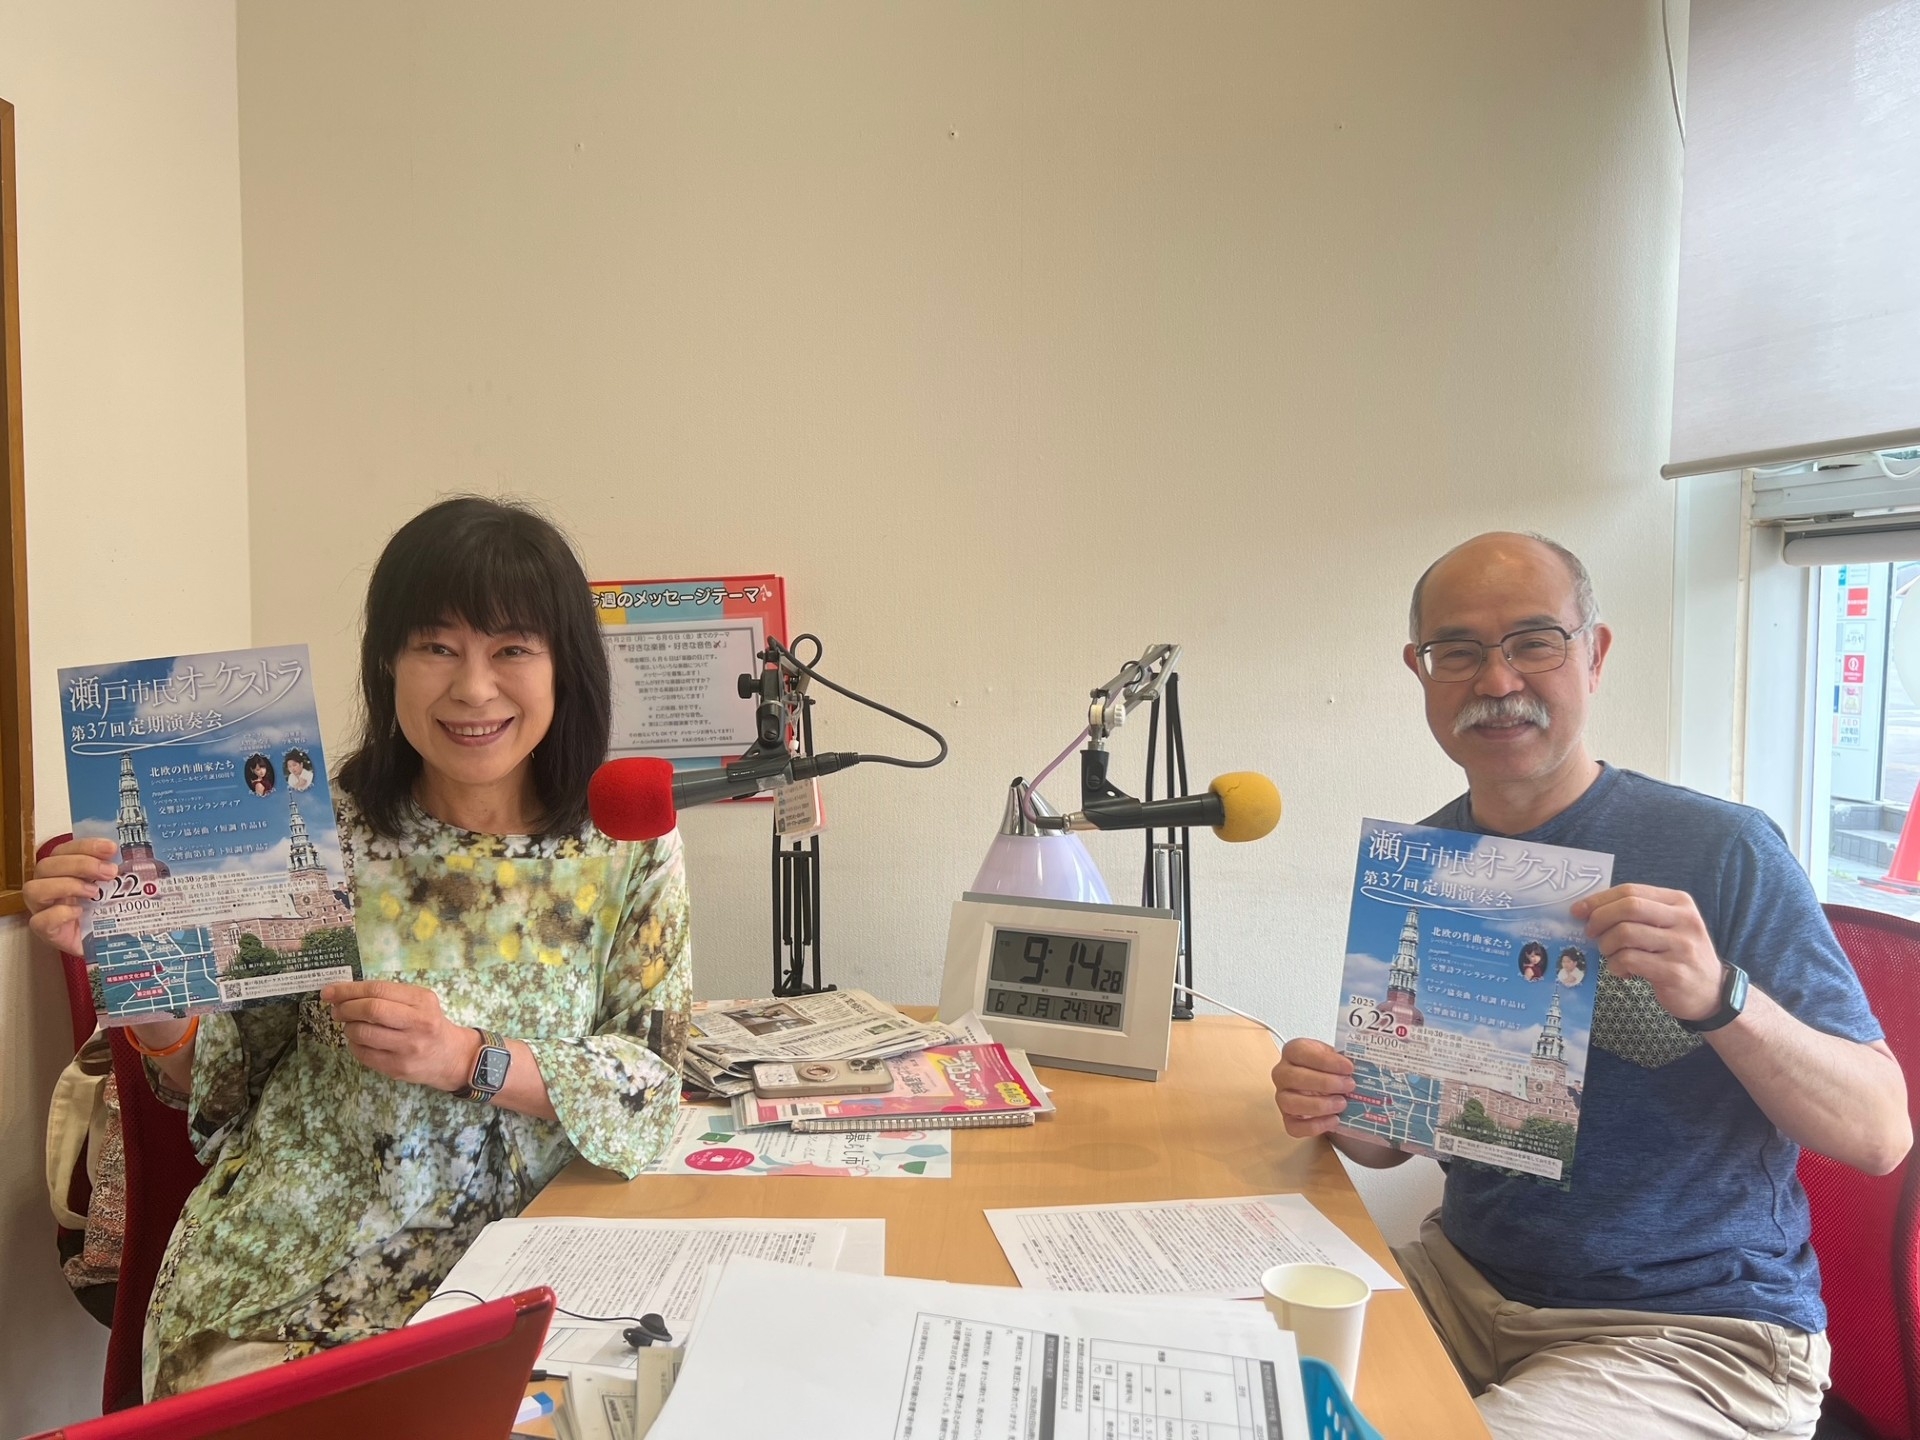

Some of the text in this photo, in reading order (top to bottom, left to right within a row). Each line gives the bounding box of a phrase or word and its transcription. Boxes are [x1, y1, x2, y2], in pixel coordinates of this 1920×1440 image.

[69, 660, 303, 720] 瀬戸市民オーケストラ
[71, 709, 223, 742] 第37回定期演奏会
[150, 760, 235, 778] 北欧の作曲家たち
[159, 799, 241, 815] 交響詩フィンランディア
[162, 826, 210, 838] ピアノ協奏曲
[240, 820, 268, 830] 作品16
[1369, 828, 1603, 892] 瀬戸市民オーケストラ
[1363, 869, 1513, 909] 第37回定期演奏会
[1431, 926, 1512, 949] 北欧の作曲家たち
[1020, 936, 1123, 993] 9:14 28
[1431, 963, 1509, 982] 交響詩フィンランディア
[995, 992, 1005, 1012] 6
[1016, 995, 1028, 1015] 2
[1032, 996, 1050, 1018] 月
[1351, 996, 1375, 1007] 2025
[841, 1132, 872, 1166] 暮らし市
